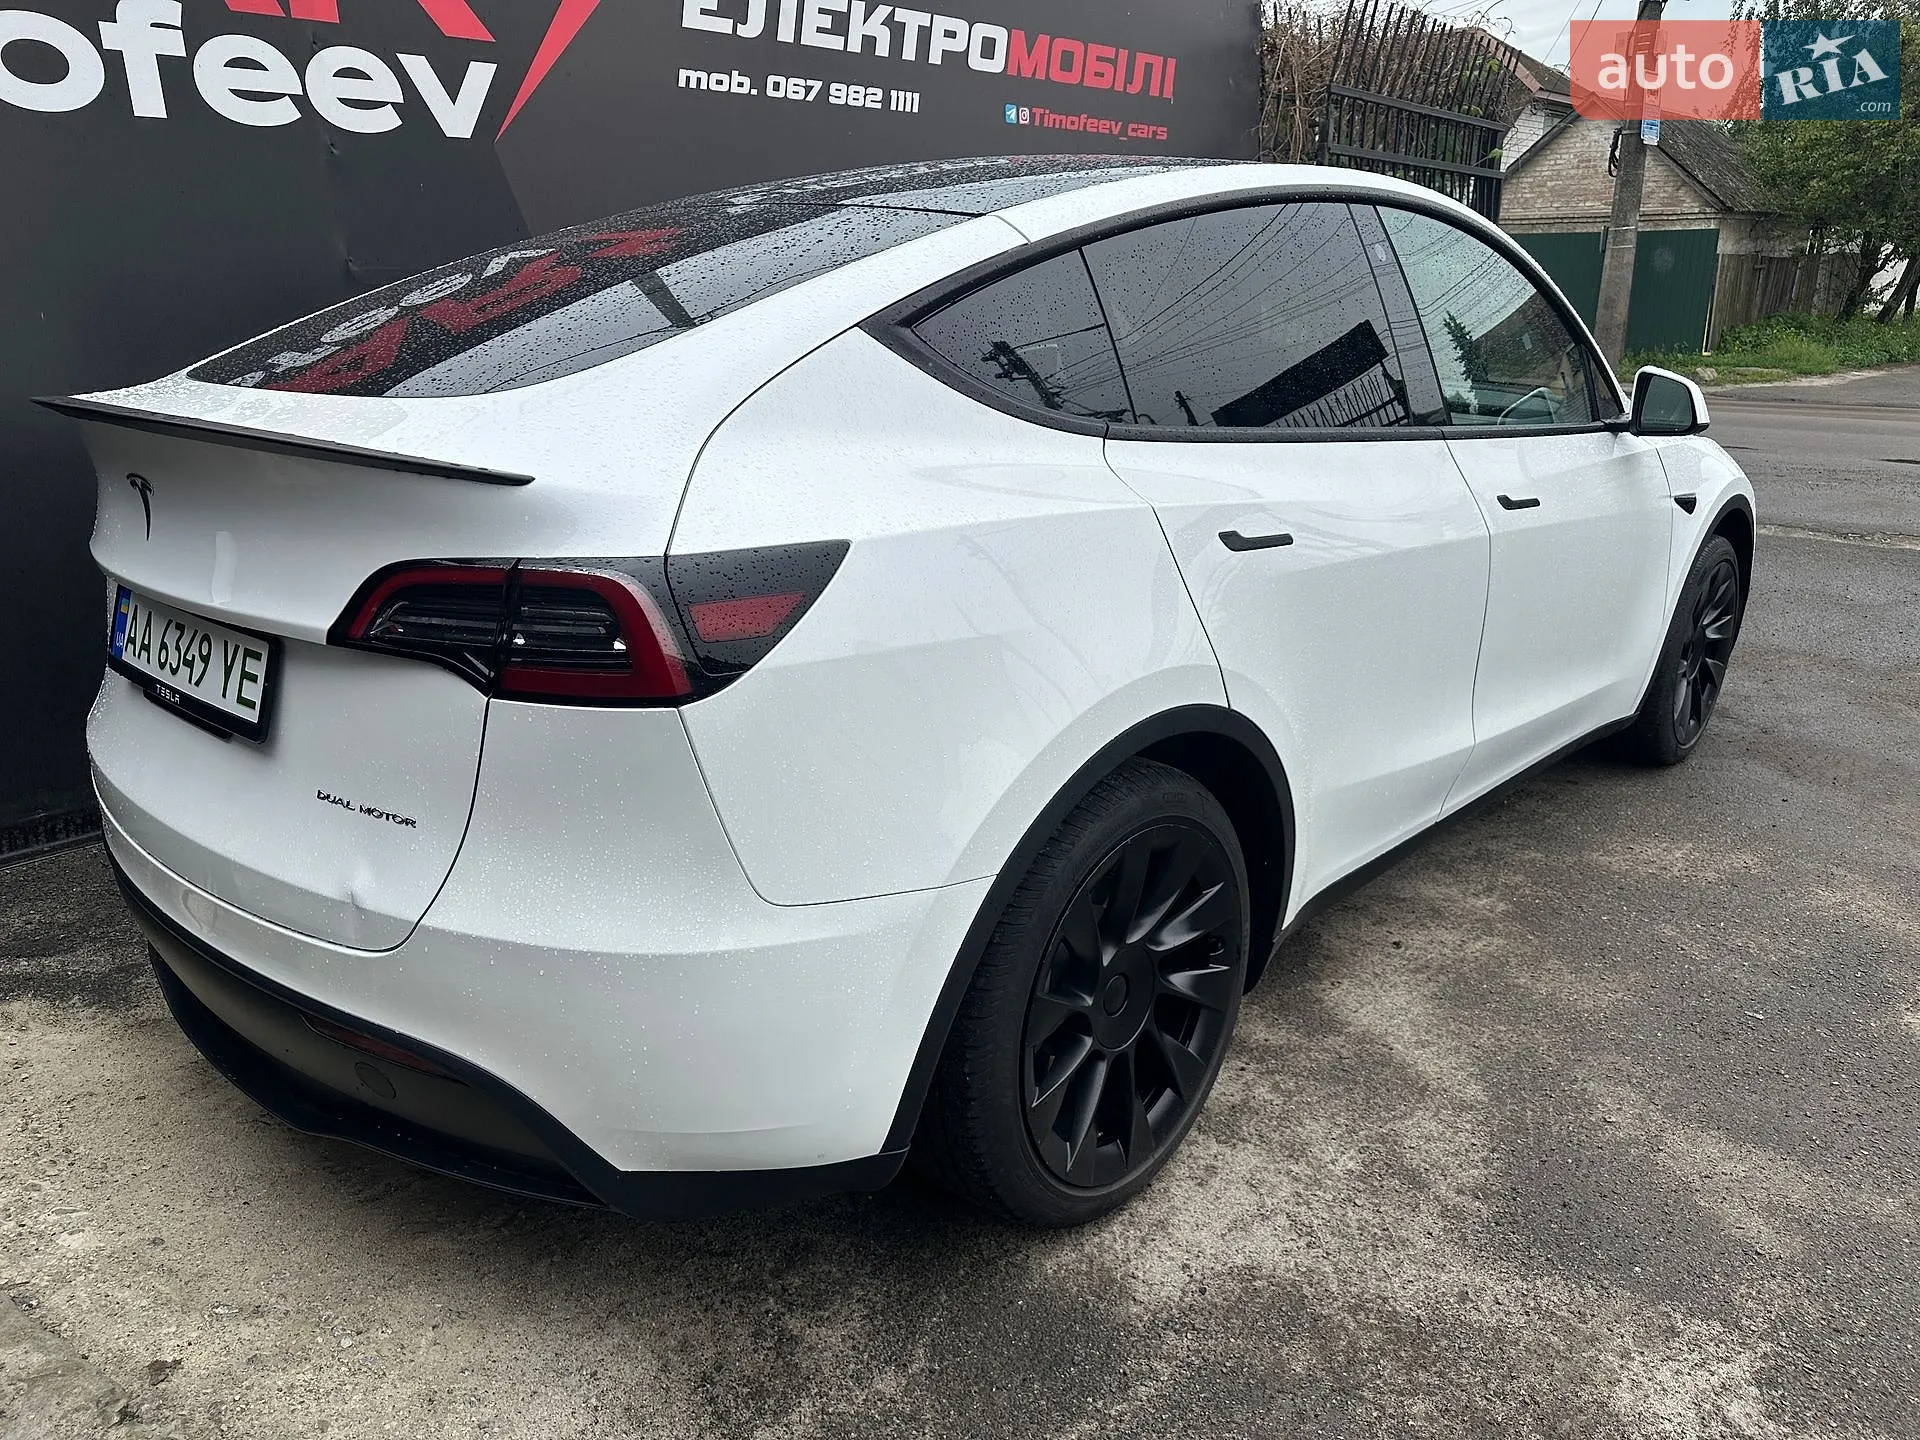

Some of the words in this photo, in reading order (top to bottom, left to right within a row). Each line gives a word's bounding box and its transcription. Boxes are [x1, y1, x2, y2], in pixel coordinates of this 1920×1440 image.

[677, 68, 758, 96] mob.
[765, 74, 823, 102] 067
[828, 82, 884, 109] 982
[889, 89, 920, 113] 1111
[1031, 107, 1167, 140] Timofeev_cars
[124, 604, 153, 665] AA
[157, 618, 213, 688] 6349
[221, 639, 263, 711] YE
[156, 683, 180, 705] TESLA
[316, 789, 355, 812] DUAL
[359, 804, 417, 829] MOTOR
